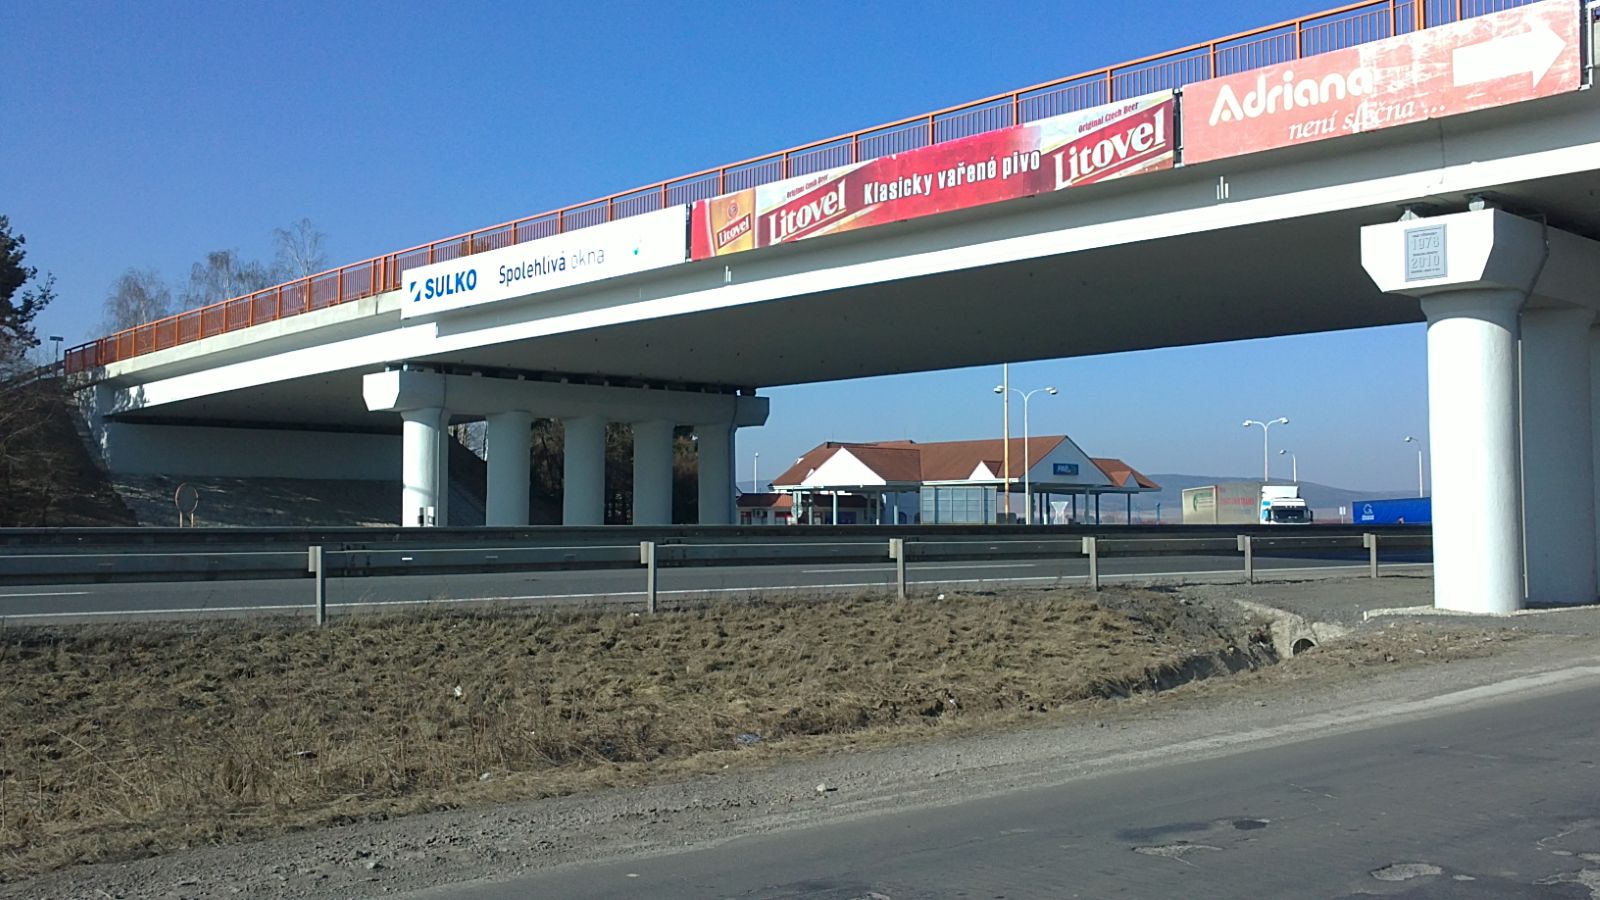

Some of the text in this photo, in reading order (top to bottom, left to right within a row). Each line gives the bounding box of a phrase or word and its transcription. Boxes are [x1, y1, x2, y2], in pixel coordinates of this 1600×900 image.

[1078, 102, 1140, 133] Original Czech Beer
[1208, 67, 1375, 127] Adriana
[1053, 107, 1166, 191] Litovel
[1288, 109, 1337, 140] není
[863, 150, 1041, 205] Klasicky vařené pivo
[719, 215, 750, 247] Litovel
[768, 179, 847, 246] Litovel
[424, 248, 605, 300] SULKO Spolehlivá okna
[1410, 254, 1440, 270] 2010
